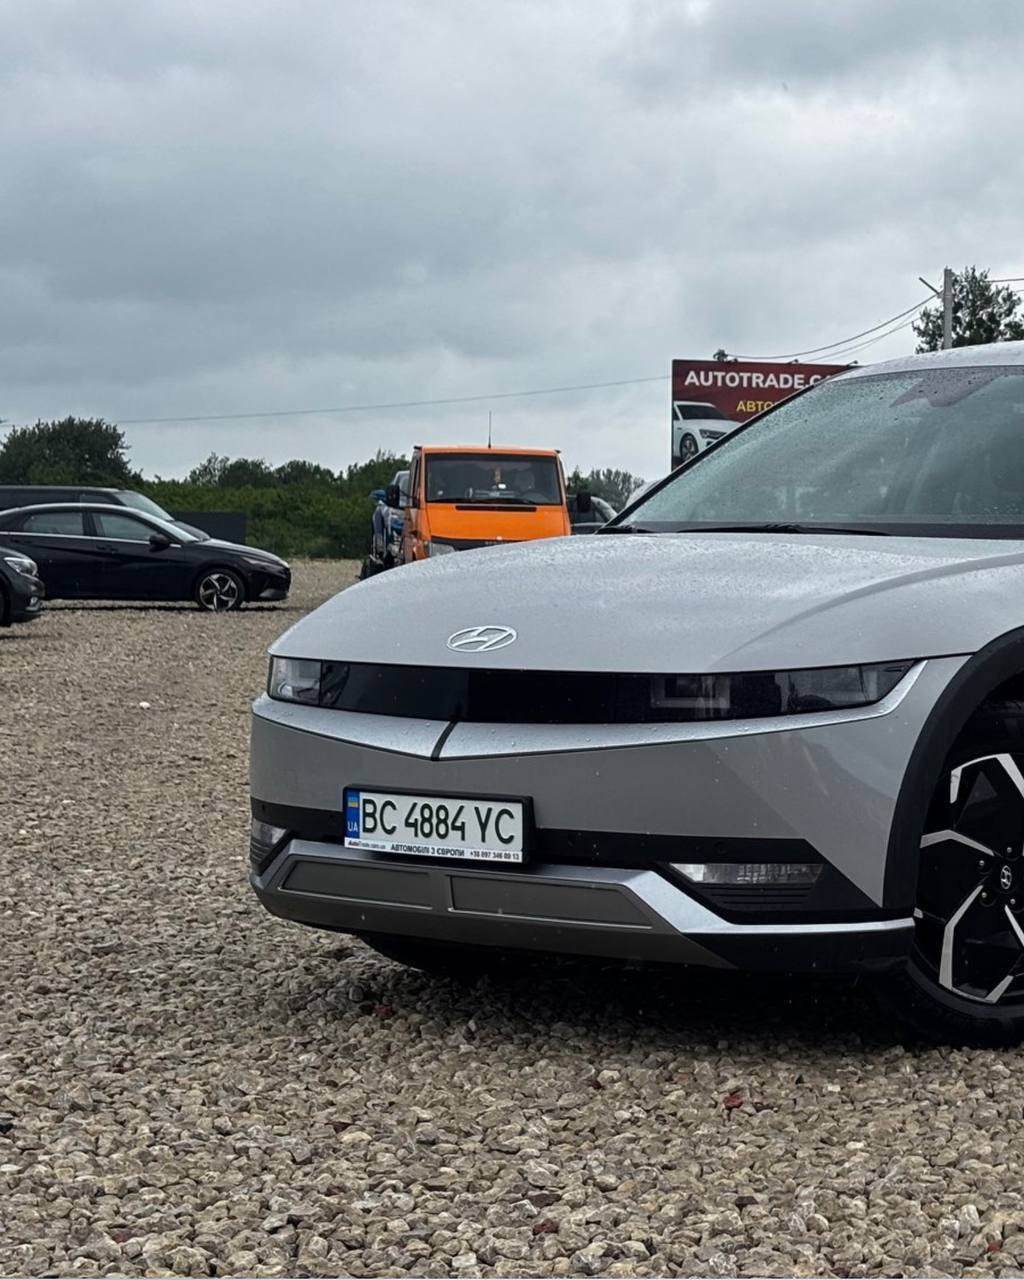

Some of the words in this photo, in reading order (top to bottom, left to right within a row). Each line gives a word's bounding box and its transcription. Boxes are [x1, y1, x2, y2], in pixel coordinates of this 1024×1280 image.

[684, 370, 832, 389] AUTOTRADE.C
[347, 821, 359, 832] UA
[362, 798, 397, 835] BC
[404, 802, 466, 841] 4884
[474, 806, 515, 845] YC
